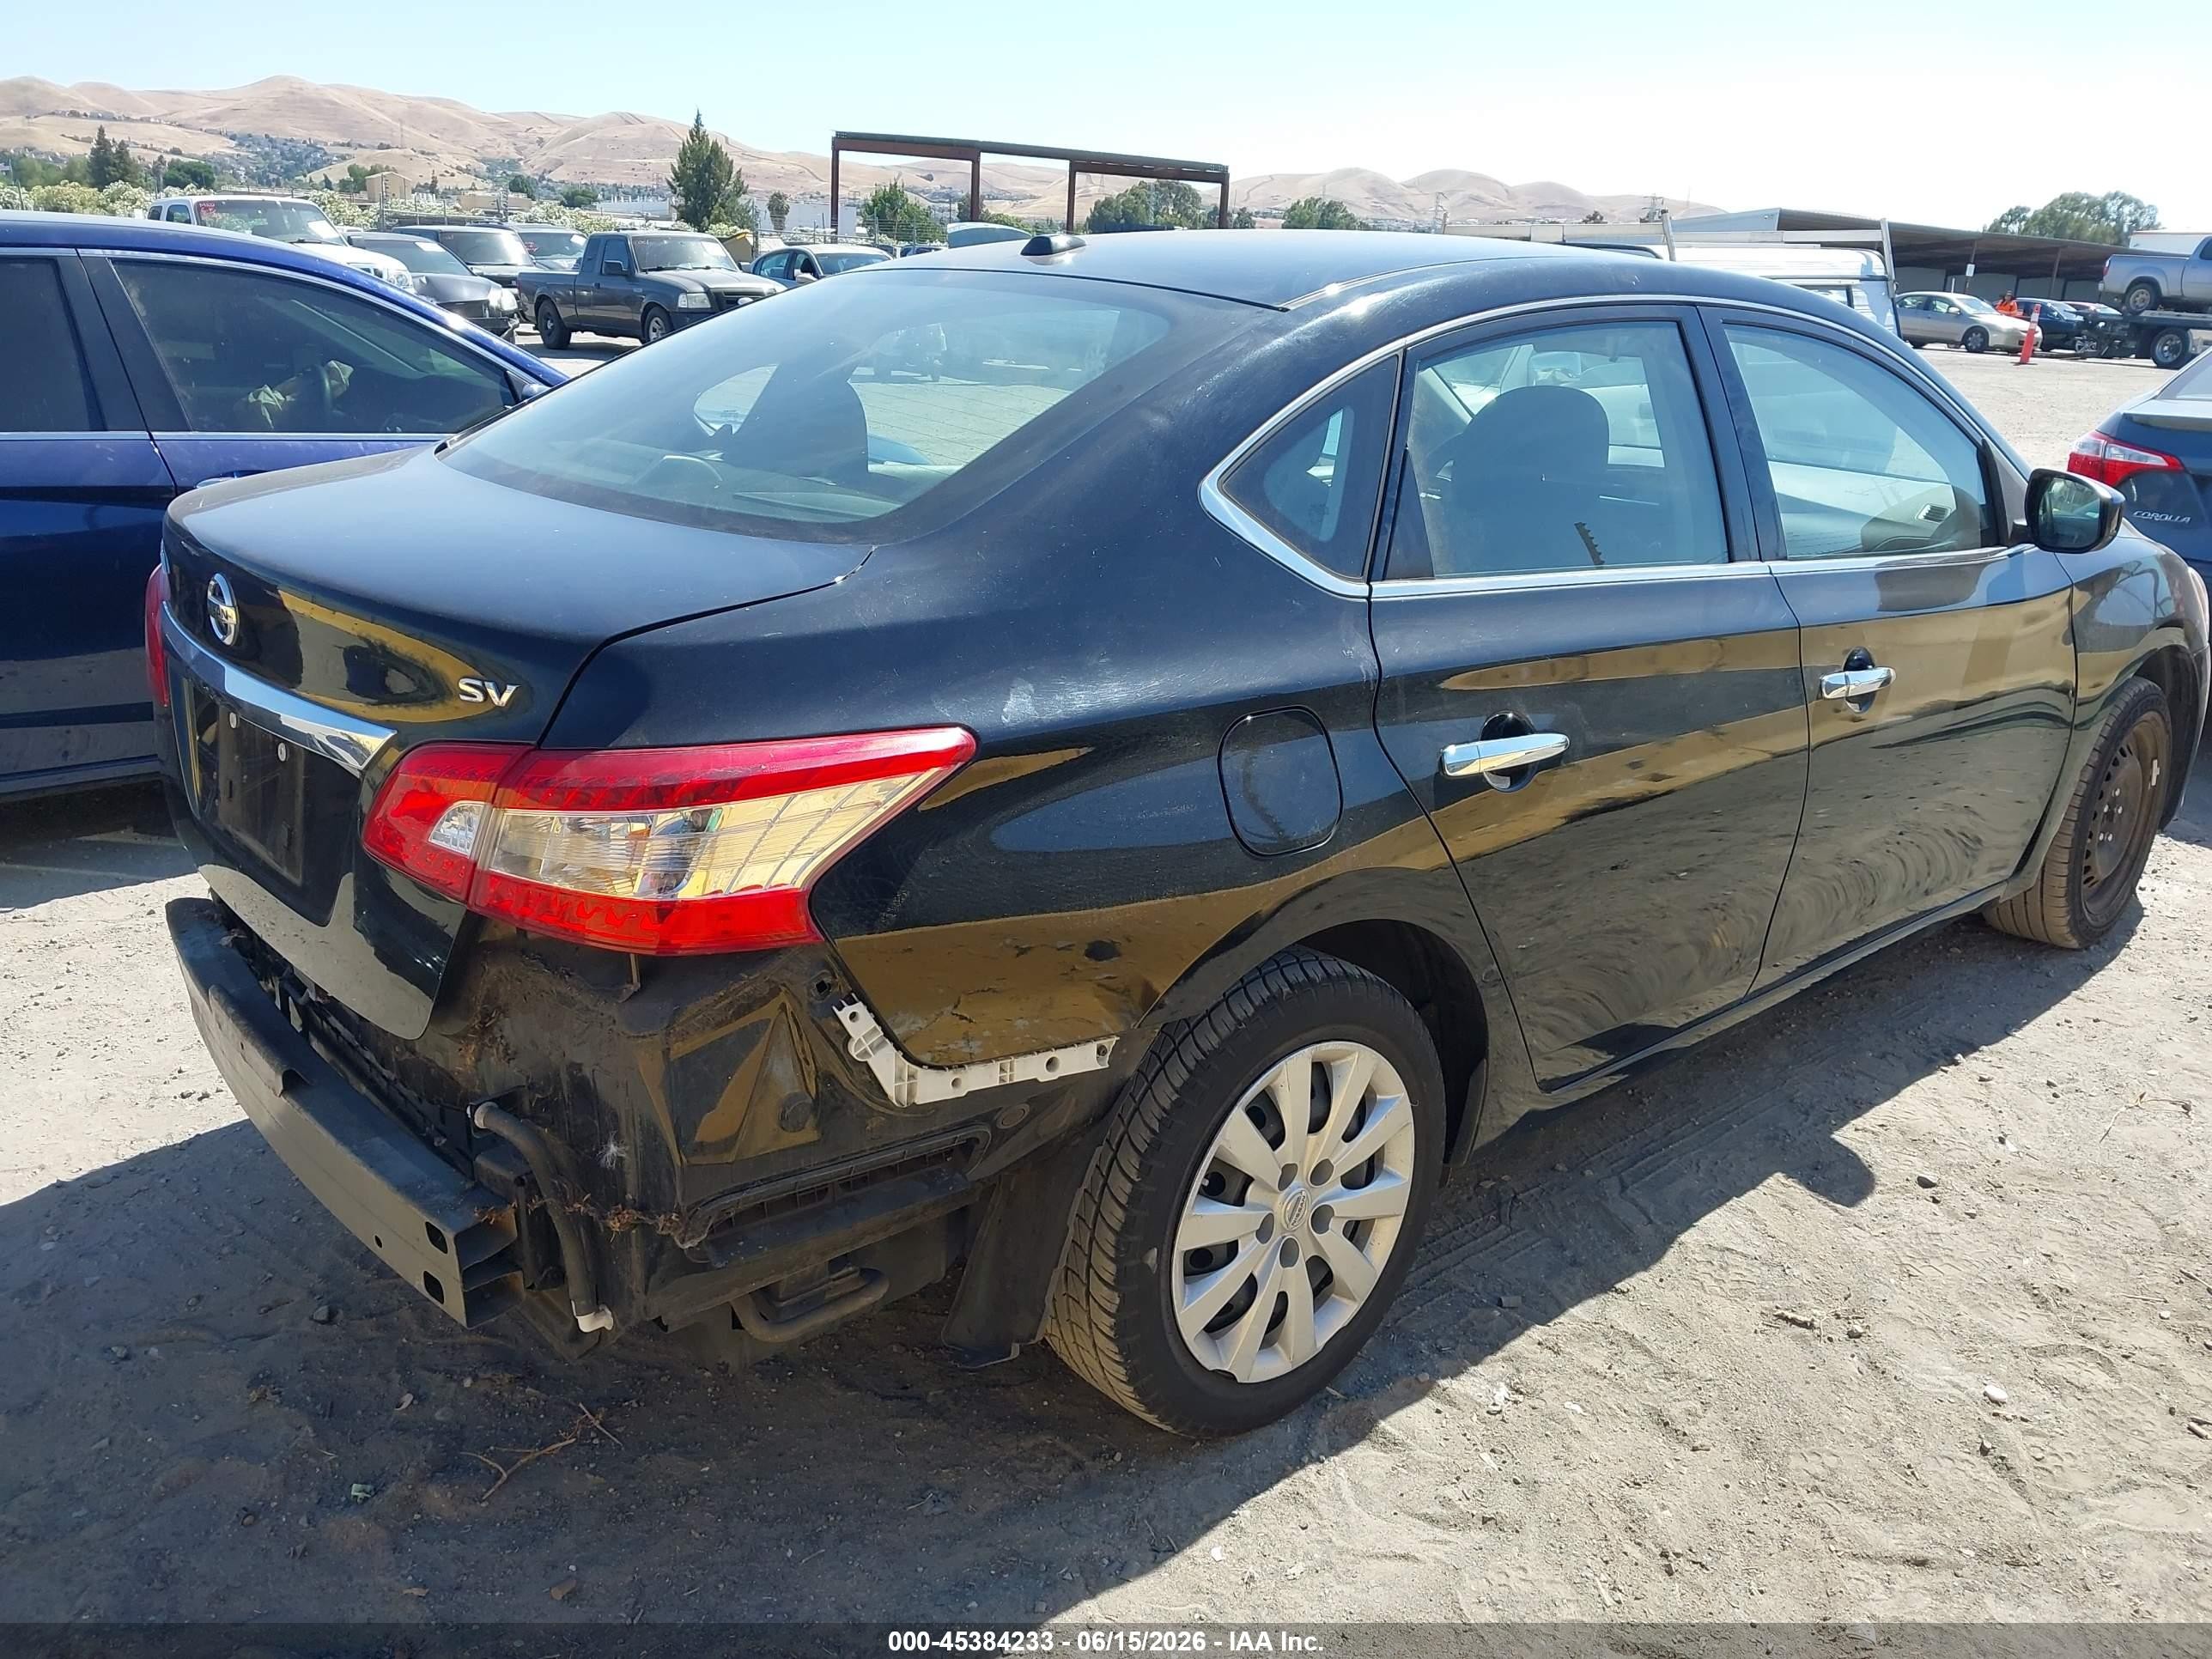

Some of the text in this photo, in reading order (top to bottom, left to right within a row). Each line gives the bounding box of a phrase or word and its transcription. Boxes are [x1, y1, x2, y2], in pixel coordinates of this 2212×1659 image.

[2132, 510, 2191, 523] COROLLA
[459, 678, 521, 707] SV
[1291, 1195, 1306, 1226] NISSAN
